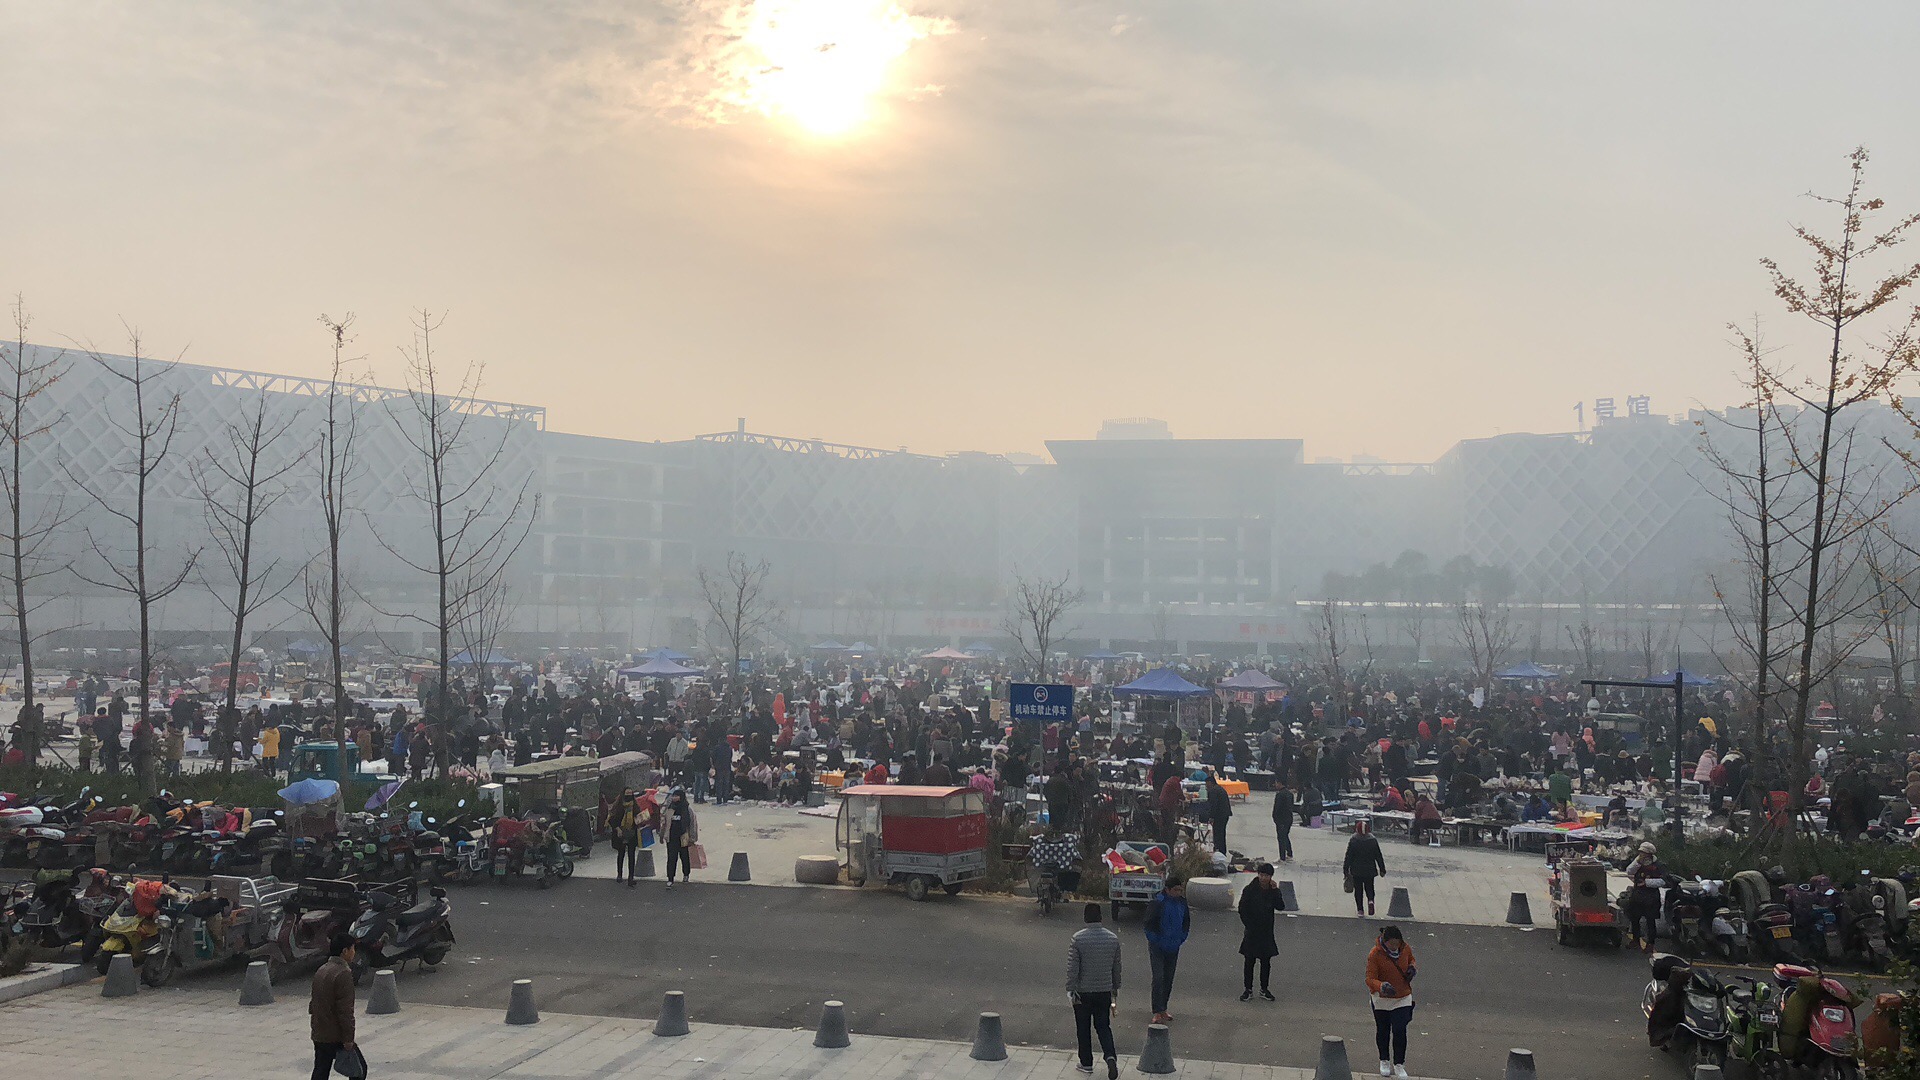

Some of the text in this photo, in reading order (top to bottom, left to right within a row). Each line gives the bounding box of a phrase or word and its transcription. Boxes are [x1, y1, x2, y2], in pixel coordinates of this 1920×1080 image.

[1015, 704, 1067, 717] 机动车禁止停车
